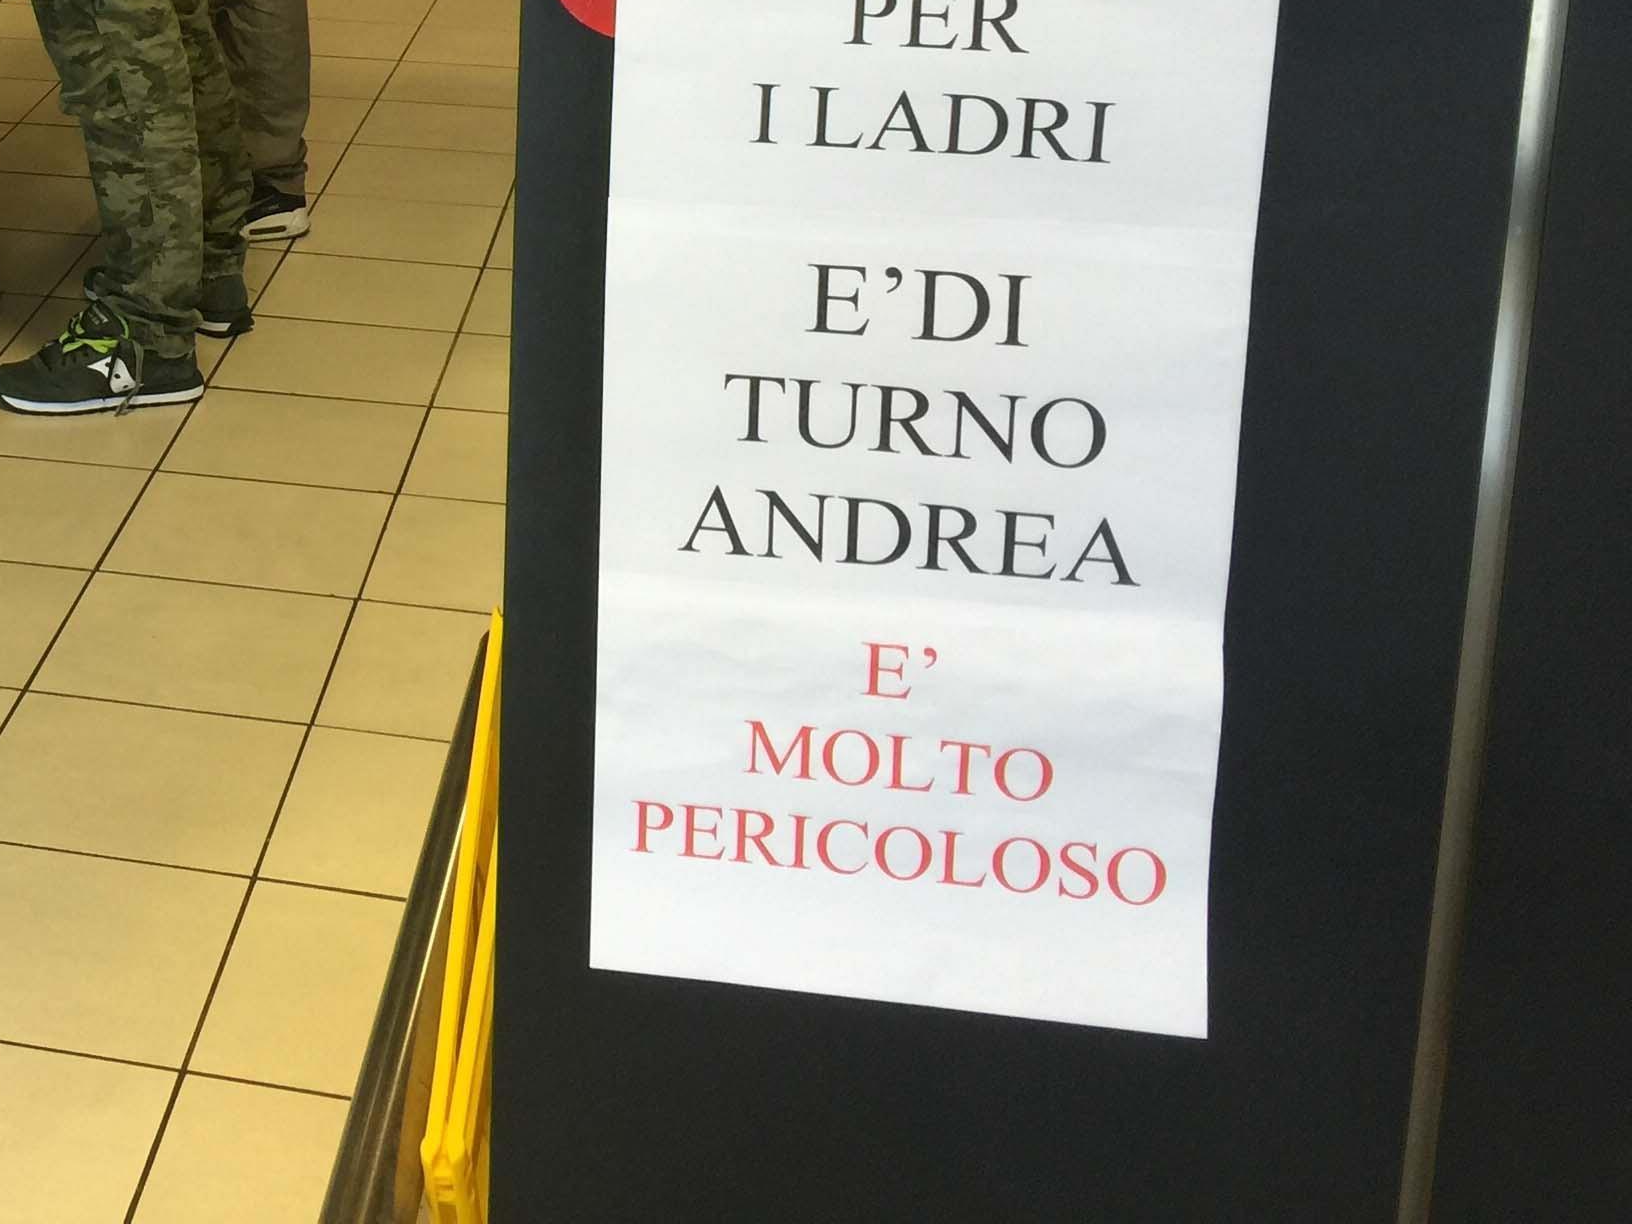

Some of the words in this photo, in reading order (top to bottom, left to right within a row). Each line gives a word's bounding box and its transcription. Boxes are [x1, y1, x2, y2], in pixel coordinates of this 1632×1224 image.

[749, 82, 782, 145] I
[805, 85, 1117, 164] LADRI
[724, 373, 1108, 470] TURNO
[678, 484, 1141, 588] ANDREA
[861, 641, 939, 701] E'
[744, 719, 1055, 802] MOLTO
[630, 800, 1169, 906] PERICOLOSO
